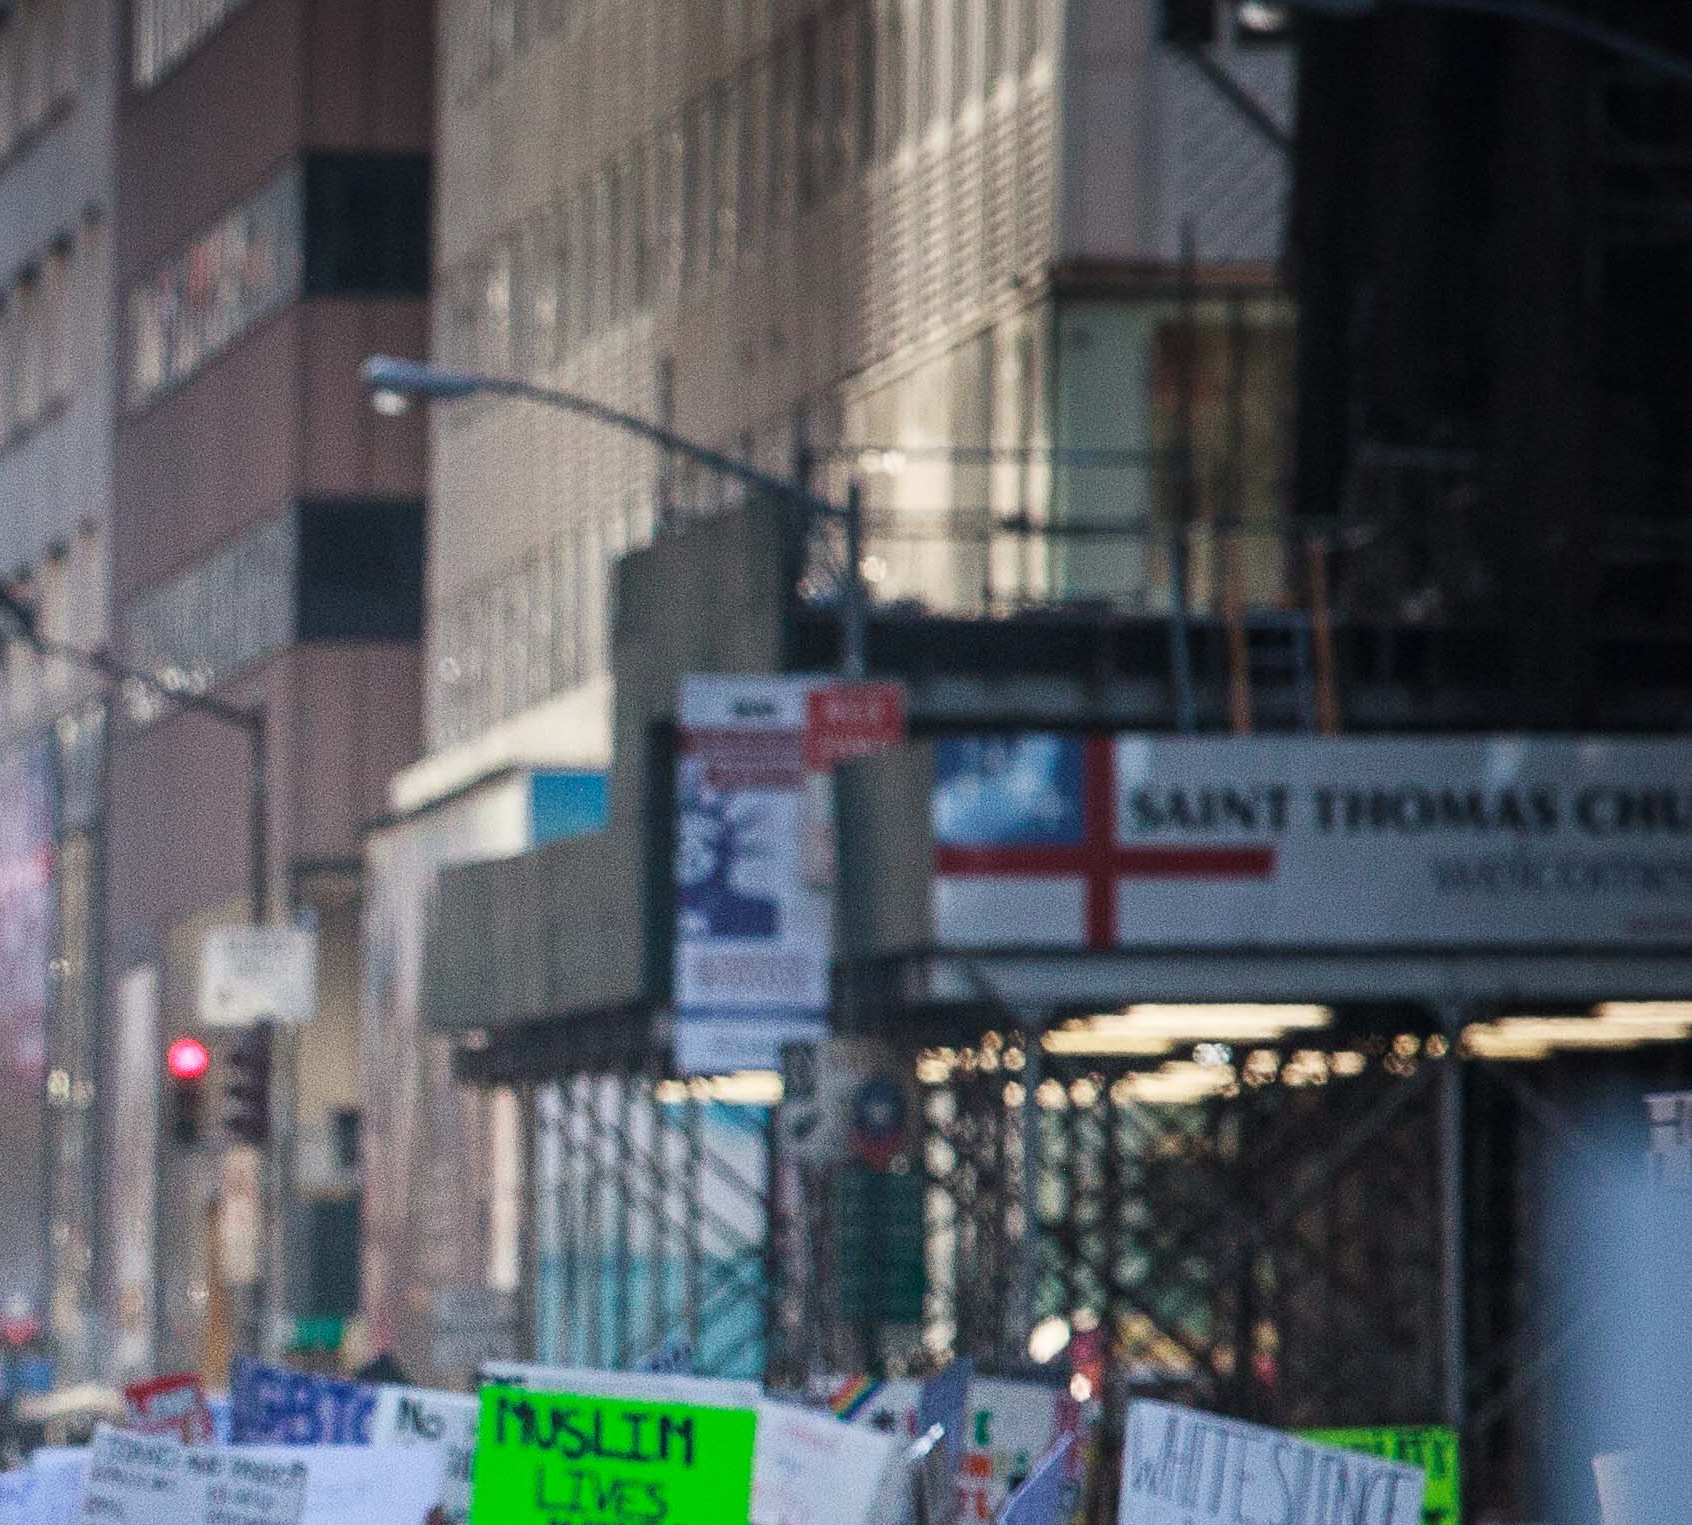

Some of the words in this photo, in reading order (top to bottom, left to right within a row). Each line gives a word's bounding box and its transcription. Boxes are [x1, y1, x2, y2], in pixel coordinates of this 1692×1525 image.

[1130, 783, 1289, 831] SAINT
[1315, 784, 1561, 833] THOMAS
[495, 1395, 694, 1469] MUSLIM
